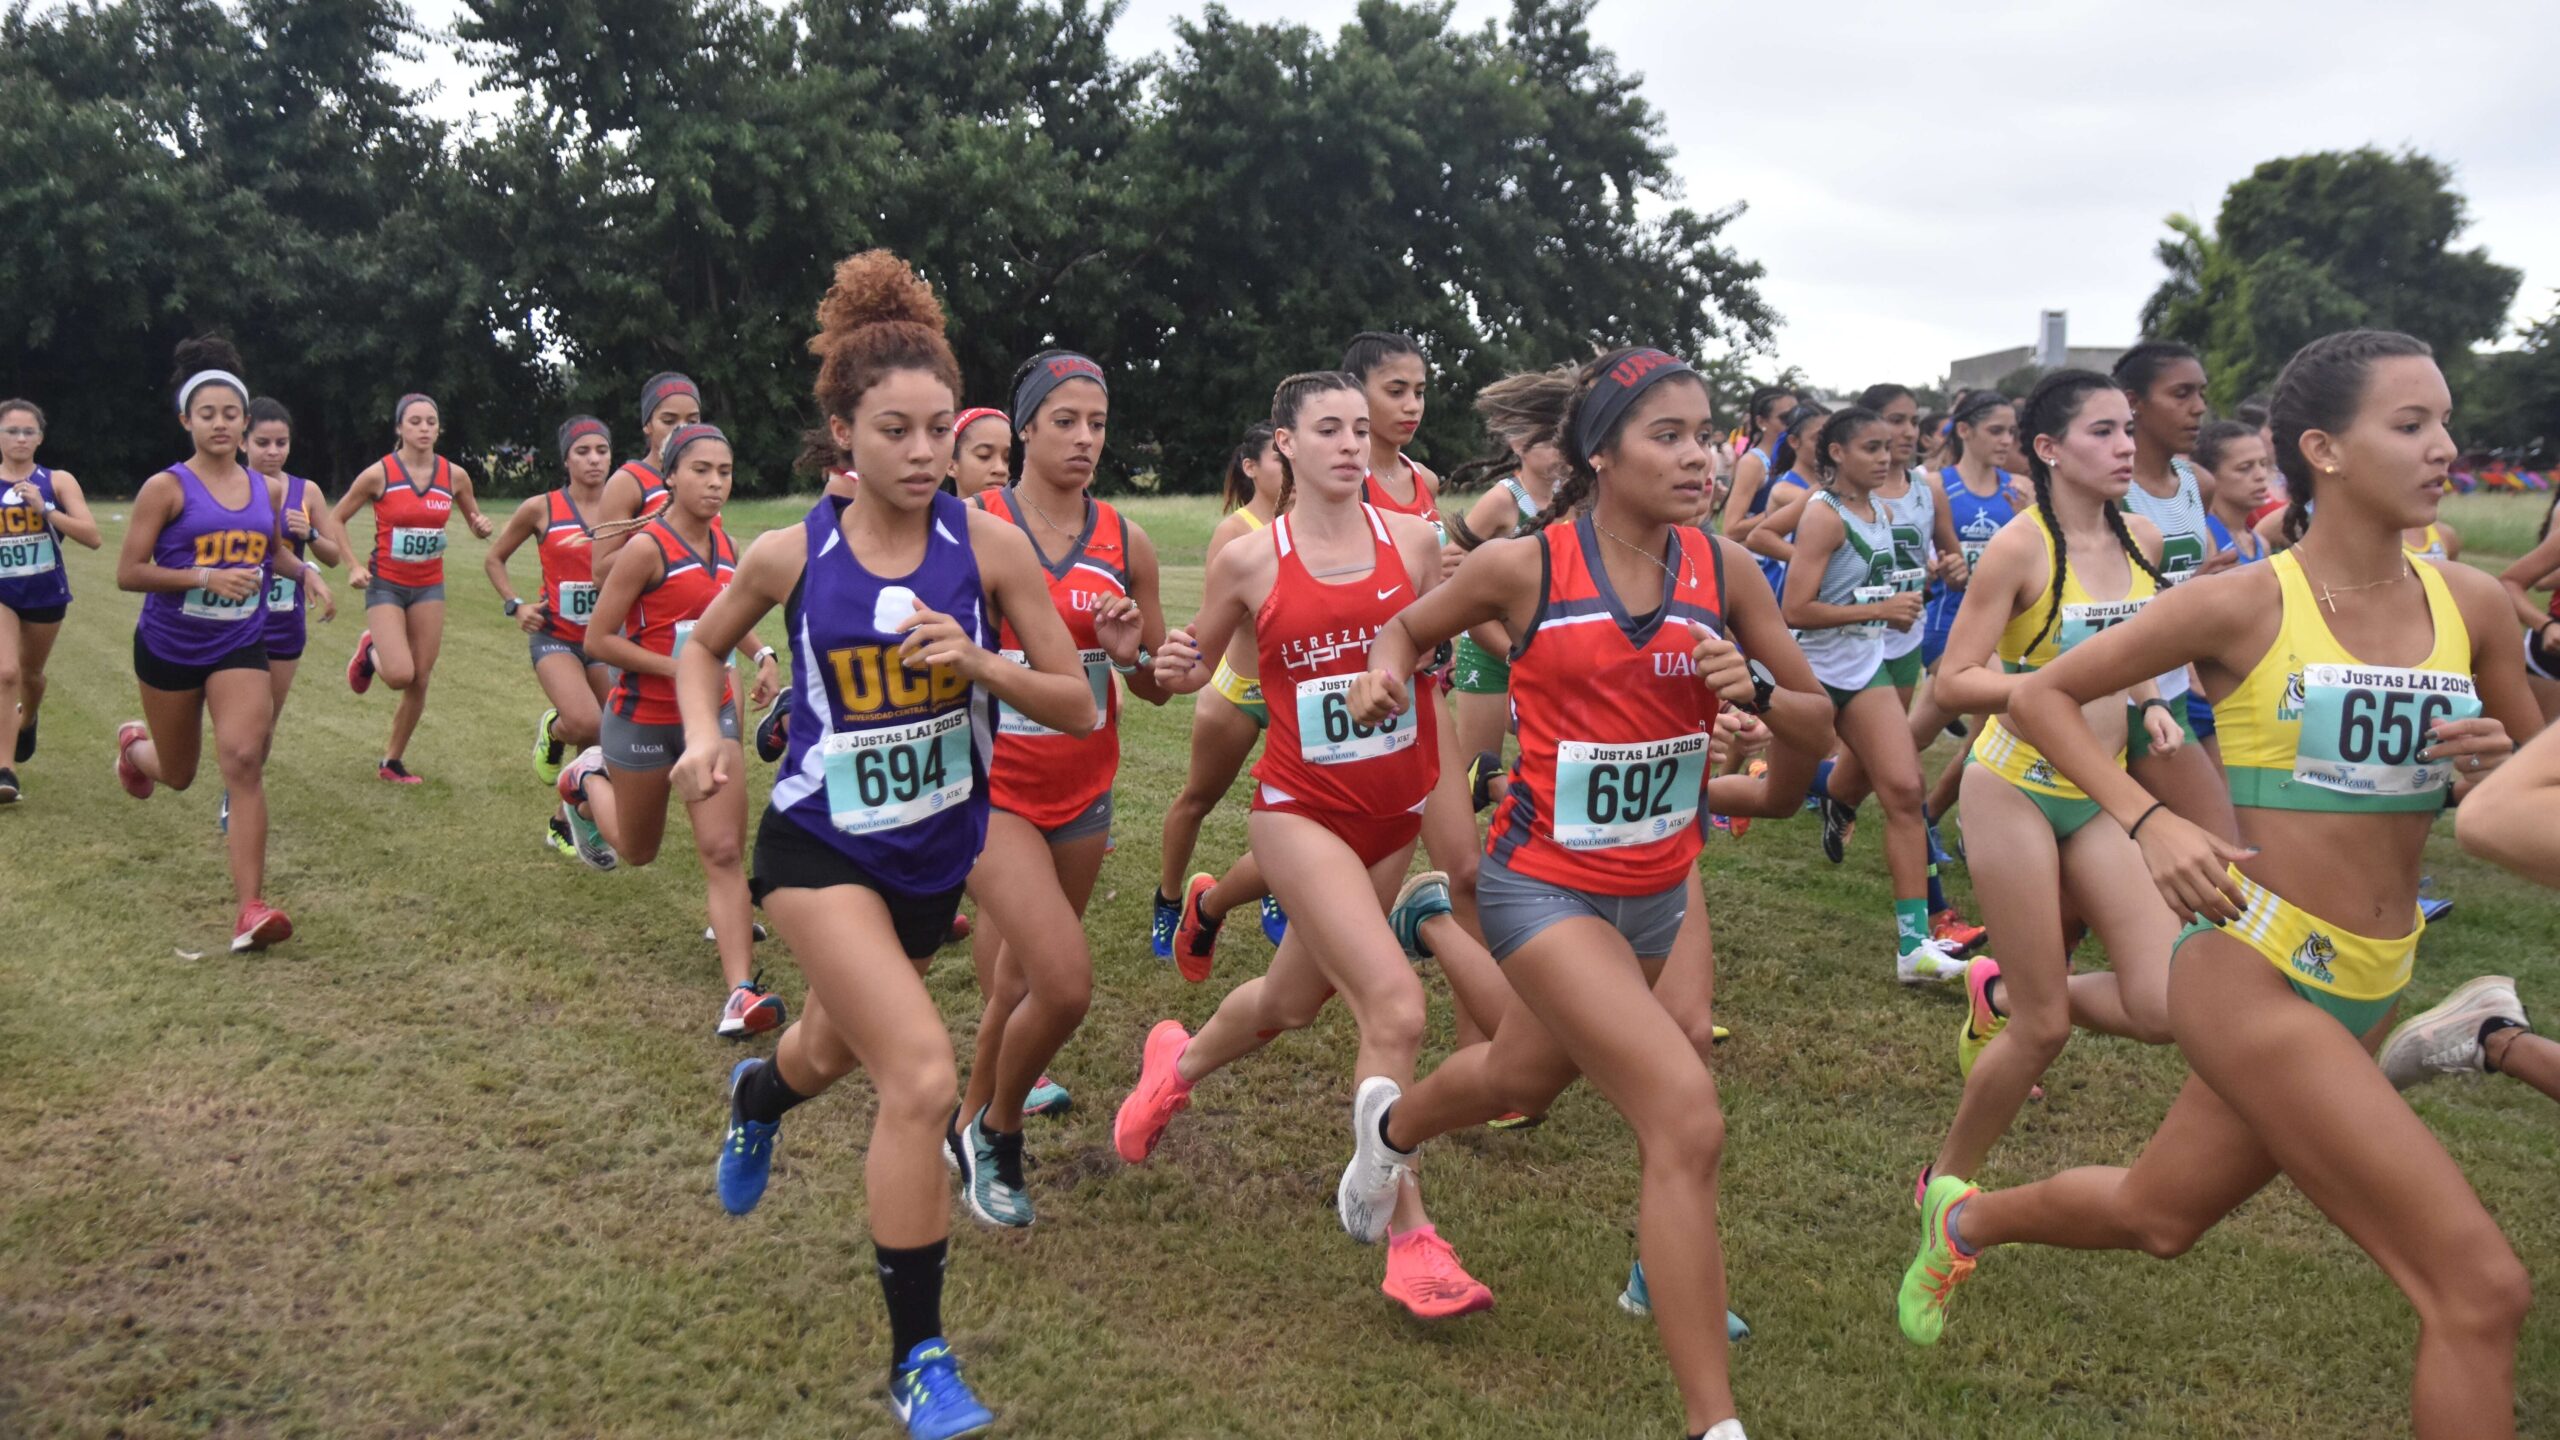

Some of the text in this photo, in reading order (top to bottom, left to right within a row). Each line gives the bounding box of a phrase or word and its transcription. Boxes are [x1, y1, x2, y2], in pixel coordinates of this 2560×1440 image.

[195, 530, 268, 566] UCB
[403, 534, 438, 555] 693
[0, 542, 39, 568] 697
[2122, 602, 2138, 614] LAI
[1083, 651, 1107, 663] 2019
[828, 644, 970, 713] UCB
[2408, 674, 2438, 690] LAI
[844, 710, 895, 722] UNIVERSIDAD
[895, 705, 928, 717] CENTRAL
[905, 725, 932, 740] LAI
[1000, 722, 1045, 733] POWERADE
[1396, 733, 1410, 744] AT&T
[631, 744, 664, 753] UAGM
[1646, 743, 1670, 759] LAI
[1312, 751, 1358, 763] POWERADE
[856, 735, 947, 807] 694
[2308, 770, 2376, 791] POWERADE
[945, 787, 963, 801] AT&T
[1586, 757, 1679, 825] 692
[1668, 817, 1687, 829] AT&T
[1565, 837, 1621, 847] POWERADE
[2291, 956, 2335, 984] INTER
